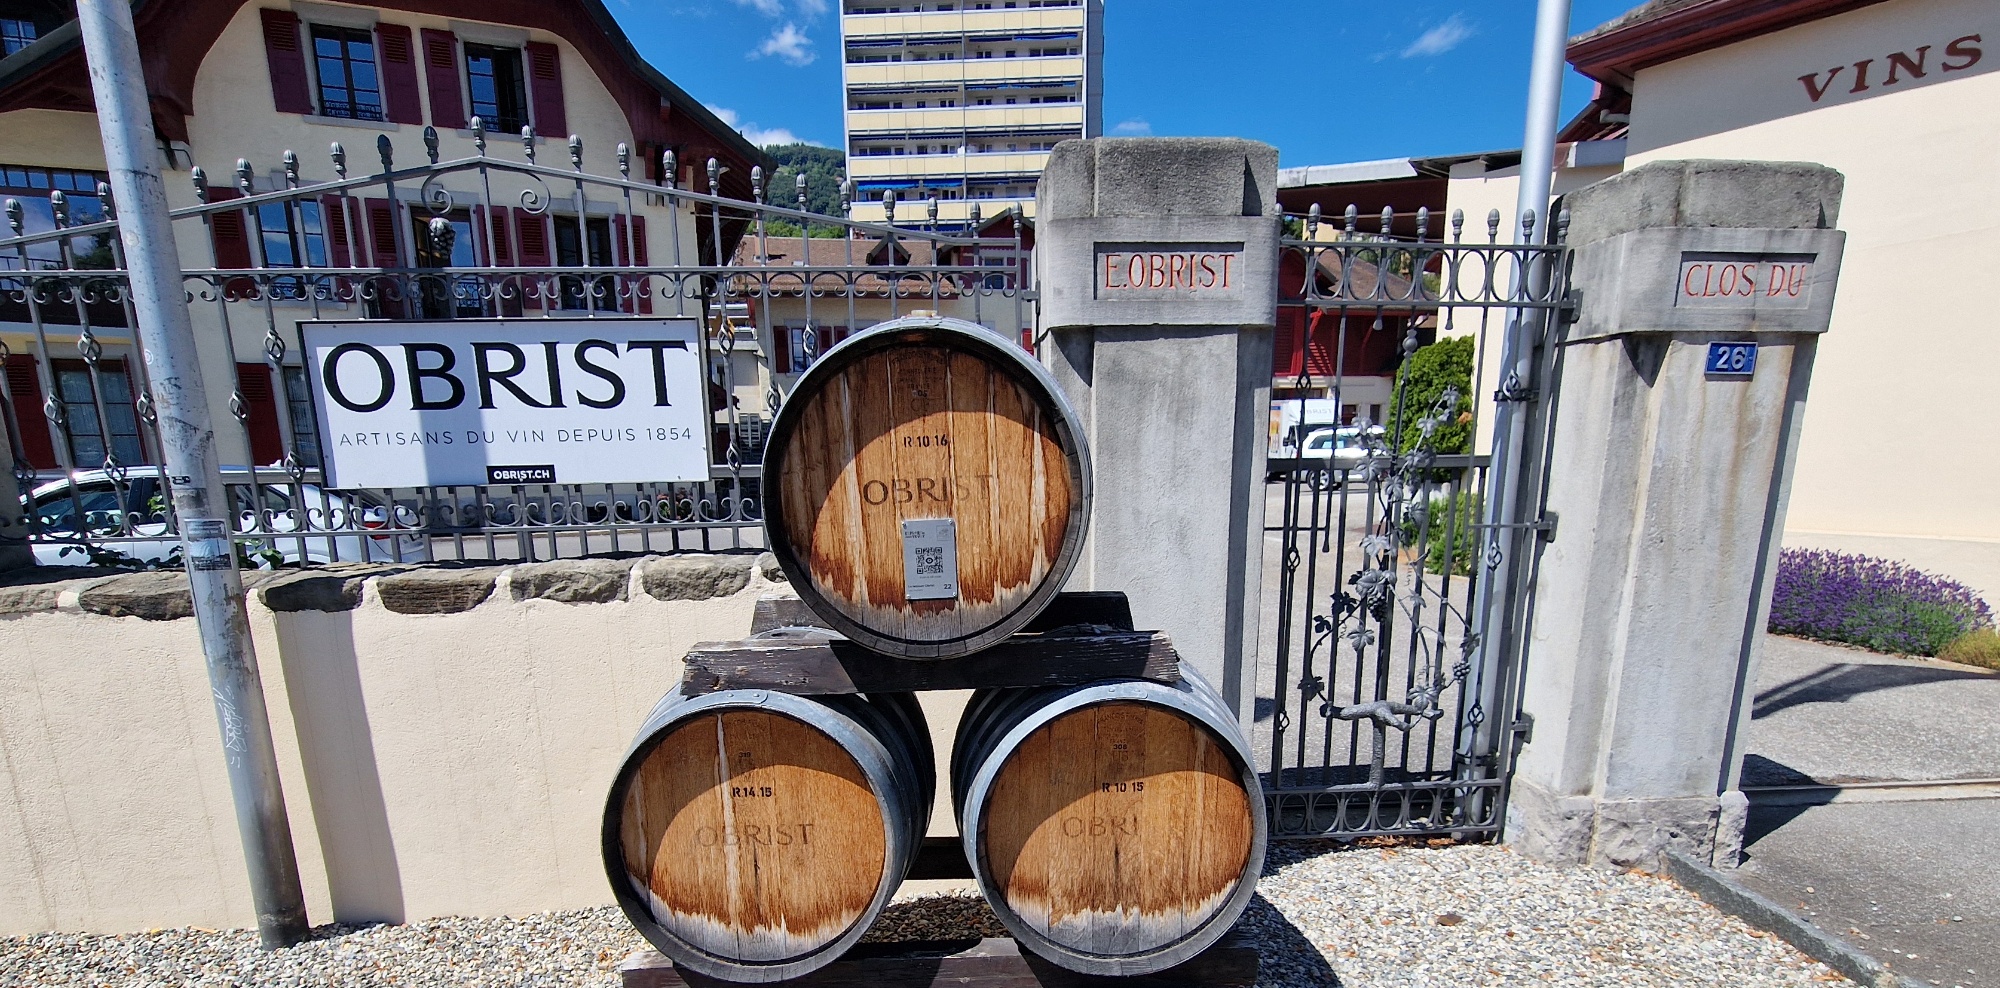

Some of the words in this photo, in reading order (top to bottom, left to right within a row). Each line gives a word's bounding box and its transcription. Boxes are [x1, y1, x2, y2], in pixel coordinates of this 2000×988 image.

[1798, 34, 1982, 102] VINS
[1105, 254, 1235, 289] E.OBRIST
[1684, 264, 1756, 298] CLOS
[1766, 264, 1806, 297] DU
[1715, 346, 1747, 370] 26
[323, 339, 688, 413] OBRIST
[340, 431, 453, 446] ARTISANS
[467, 431, 495, 444] DU
[507, 430, 544, 443] VIN
[558, 428, 636, 442] DEPUIS
[646, 427, 691, 441] 1854
[903, 436, 912, 448] R
[916, 435, 930, 447] 10
[934, 434, 948, 446] 16
[493, 469, 550, 480] OBRIST.CH
[863, 474, 993, 505] OBRIST
[1102, 782, 1110, 793] R
[1114, 782, 1127, 793] 10
[1131, 782, 1144, 793] 15
[696, 823, 813, 847] OBRIST
